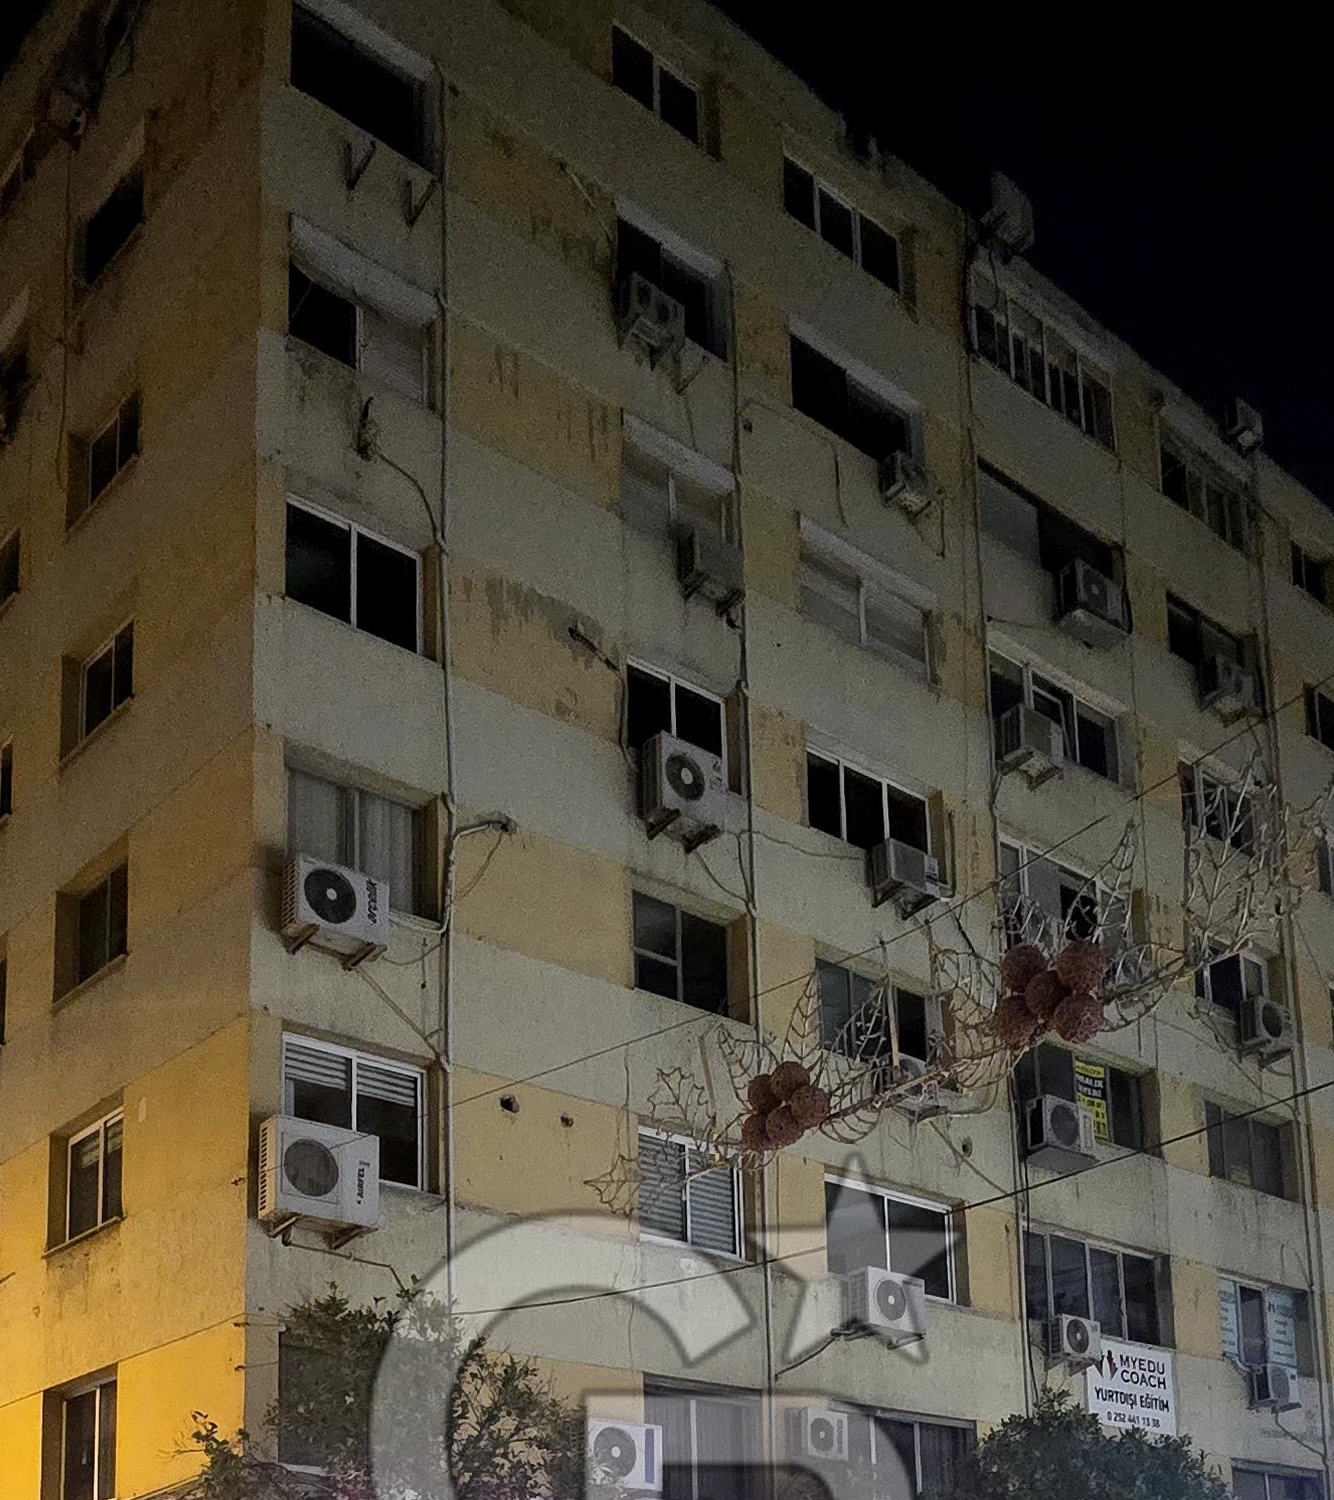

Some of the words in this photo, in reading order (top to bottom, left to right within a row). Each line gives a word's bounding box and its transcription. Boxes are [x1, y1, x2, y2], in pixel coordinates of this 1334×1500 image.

[1119, 1354, 1165, 1375] MYEDU
[1120, 1369, 1167, 1390] COACH
[1094, 1386, 1137, 1410] YURTDIŞI
